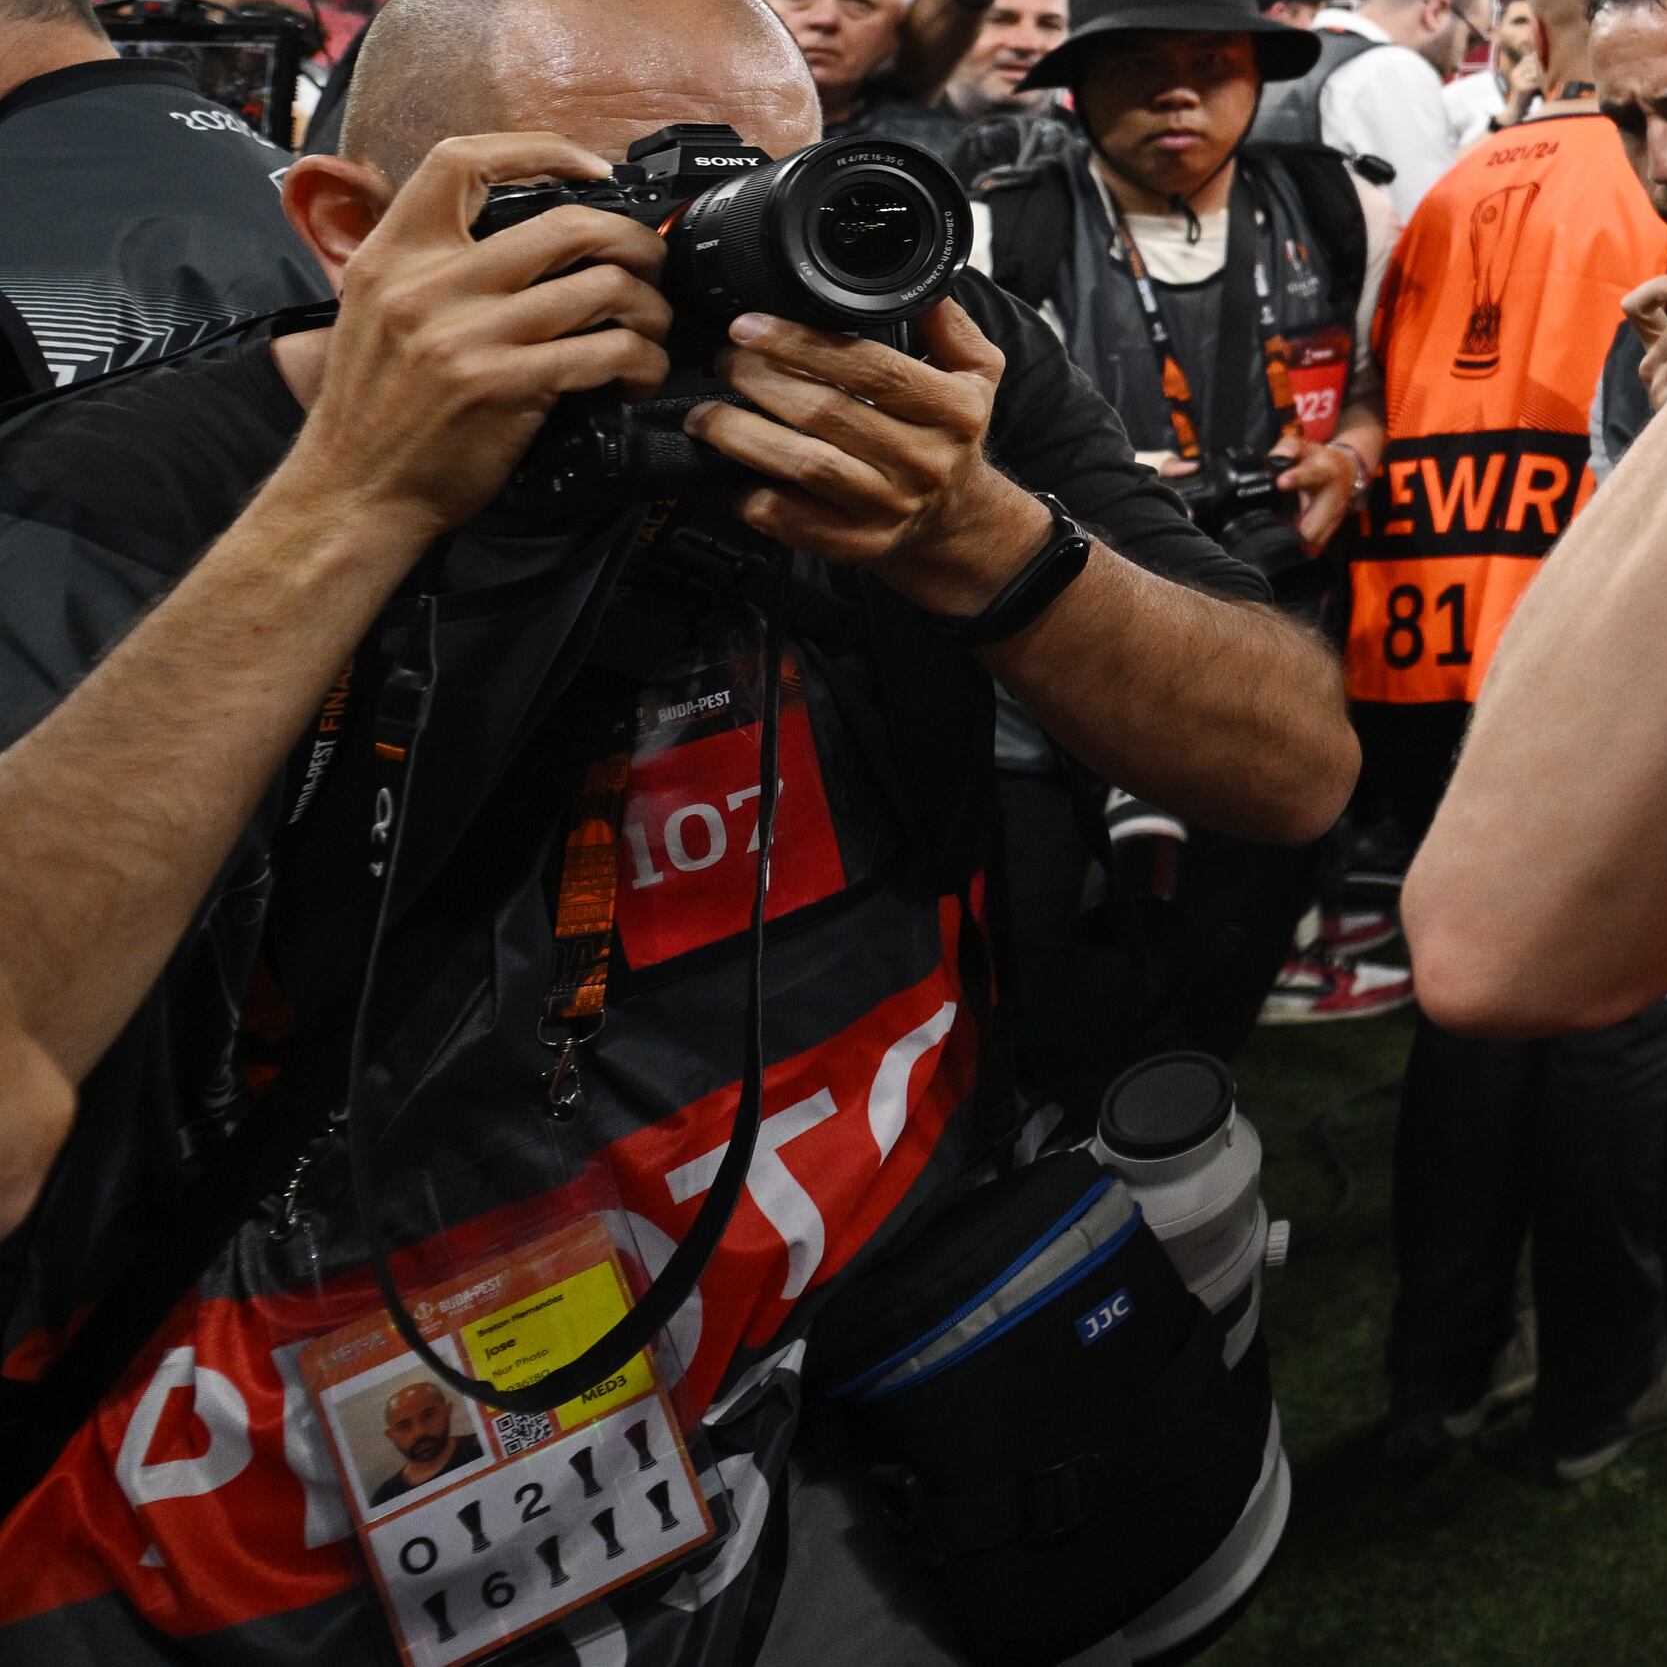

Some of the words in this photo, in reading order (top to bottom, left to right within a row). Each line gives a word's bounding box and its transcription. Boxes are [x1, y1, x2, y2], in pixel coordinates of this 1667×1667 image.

[694, 156, 760, 167] SONY
[1384, 582, 1475, 670] 81
[622, 778, 785, 890] 107
[1084, 1294, 1131, 1339] JJC
[484, 1336, 518, 1361] Jose
[491, 1362, 514, 1379] Nur
[515, 1347, 550, 1369] Photo
[580, 1374, 629, 1405] MED3
[398, 1536, 439, 1576] 0
[513, 1481, 553, 1525] 2
[480, 1570, 517, 1610] 6
